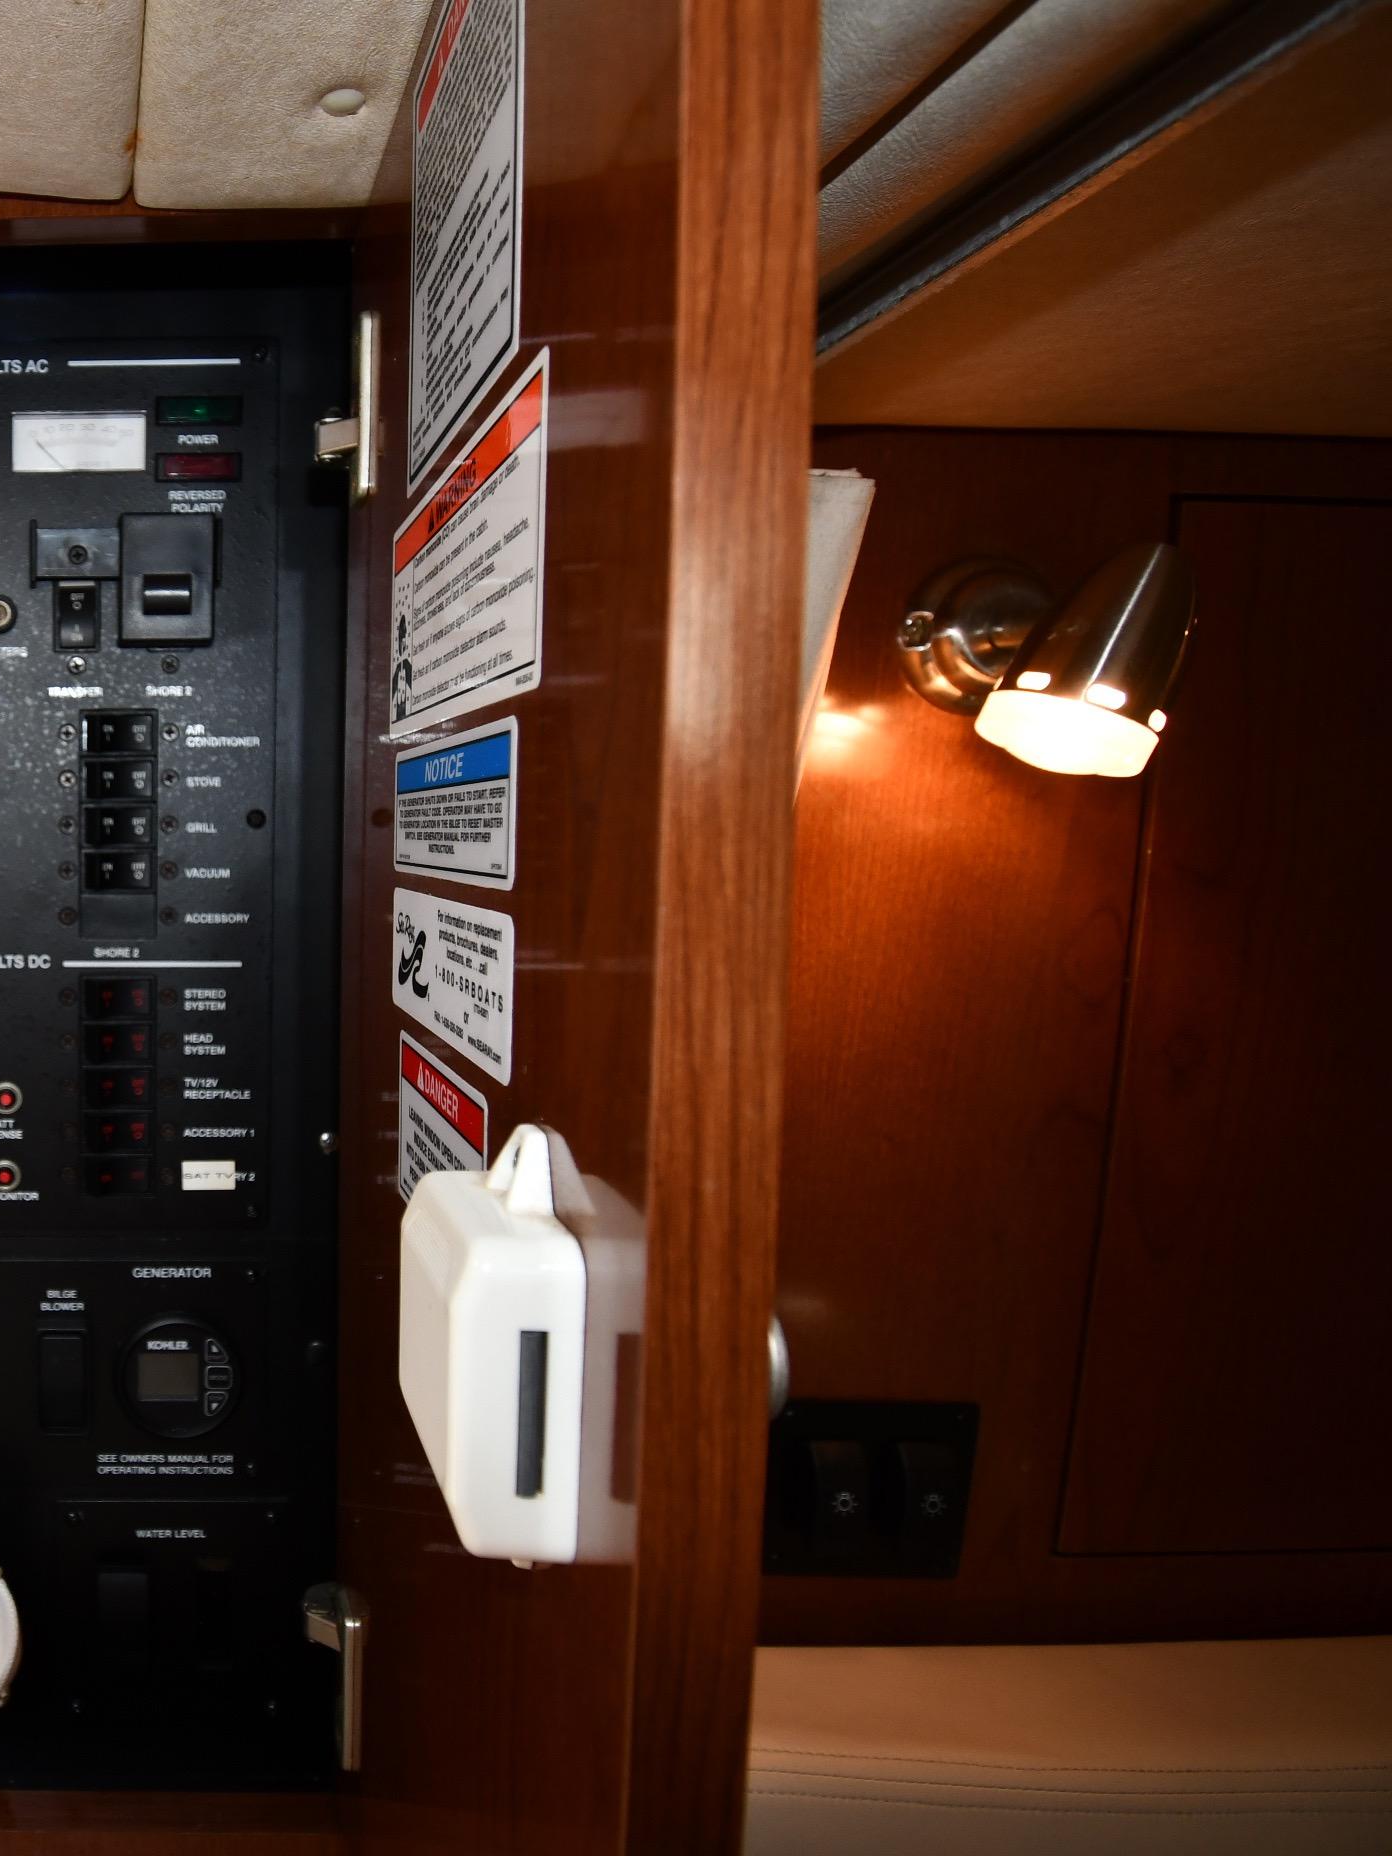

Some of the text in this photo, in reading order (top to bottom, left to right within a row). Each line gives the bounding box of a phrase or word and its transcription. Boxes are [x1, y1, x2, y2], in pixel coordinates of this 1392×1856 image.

[25, 359, 49, 373] AC
[177, 434, 219, 444] POWER
[168, 489, 227, 501] REVERSED
[435, 454, 477, 526] WARNING
[171, 502, 224, 513] POLARITY
[145, 685, 193, 697] SHORE 2
[185, 724, 205, 735] AIR
[185, 736, 261, 747] CONDITIONER
[424, 751, 464, 783] NOTICE
[186, 776, 222, 788] STOVE
[185, 823, 217, 834] GRILL
[184, 868, 230, 879] VACUUM
[184, 913, 250, 924] ACCESSORY
[93, 947, 140, 958] SHORE 2
[28, 954, 51, 969] DC
[183, 989, 226, 999] STEREO
[434, 963, 503, 1014] 1-800-SRBOATS
[183, 1001, 226, 1011] SYSTEM
[463, 1009, 470, 1025] or
[183, 1034, 213, 1044] HEAD
[183, 1045, 226, 1056] SYSTEM
[184, 1078, 219, 1088] TV/12V
[184, 1090, 251, 1100] RECEPTACLE
[423, 1067, 458, 1123] DANGER
[183, 1128, 255, 1138] ACCESSORY 1
[407, 1104, 453, 1166] LEAVING WINDOW OPEN
[413, 1129, 427, 1158] INDUCE
[132, 1267, 212, 1278] GENERATOR
[46, 1290, 78, 1299] BILGE
[40, 1302, 85, 1312] BLOWER
[97, 1455, 234, 1463] SEE OWNERS MANUAL FOR
[97, 1466, 234, 1475] OPERATING INSTRUCTIONS
[136, 1530, 206, 1539] WATER LEVEL
